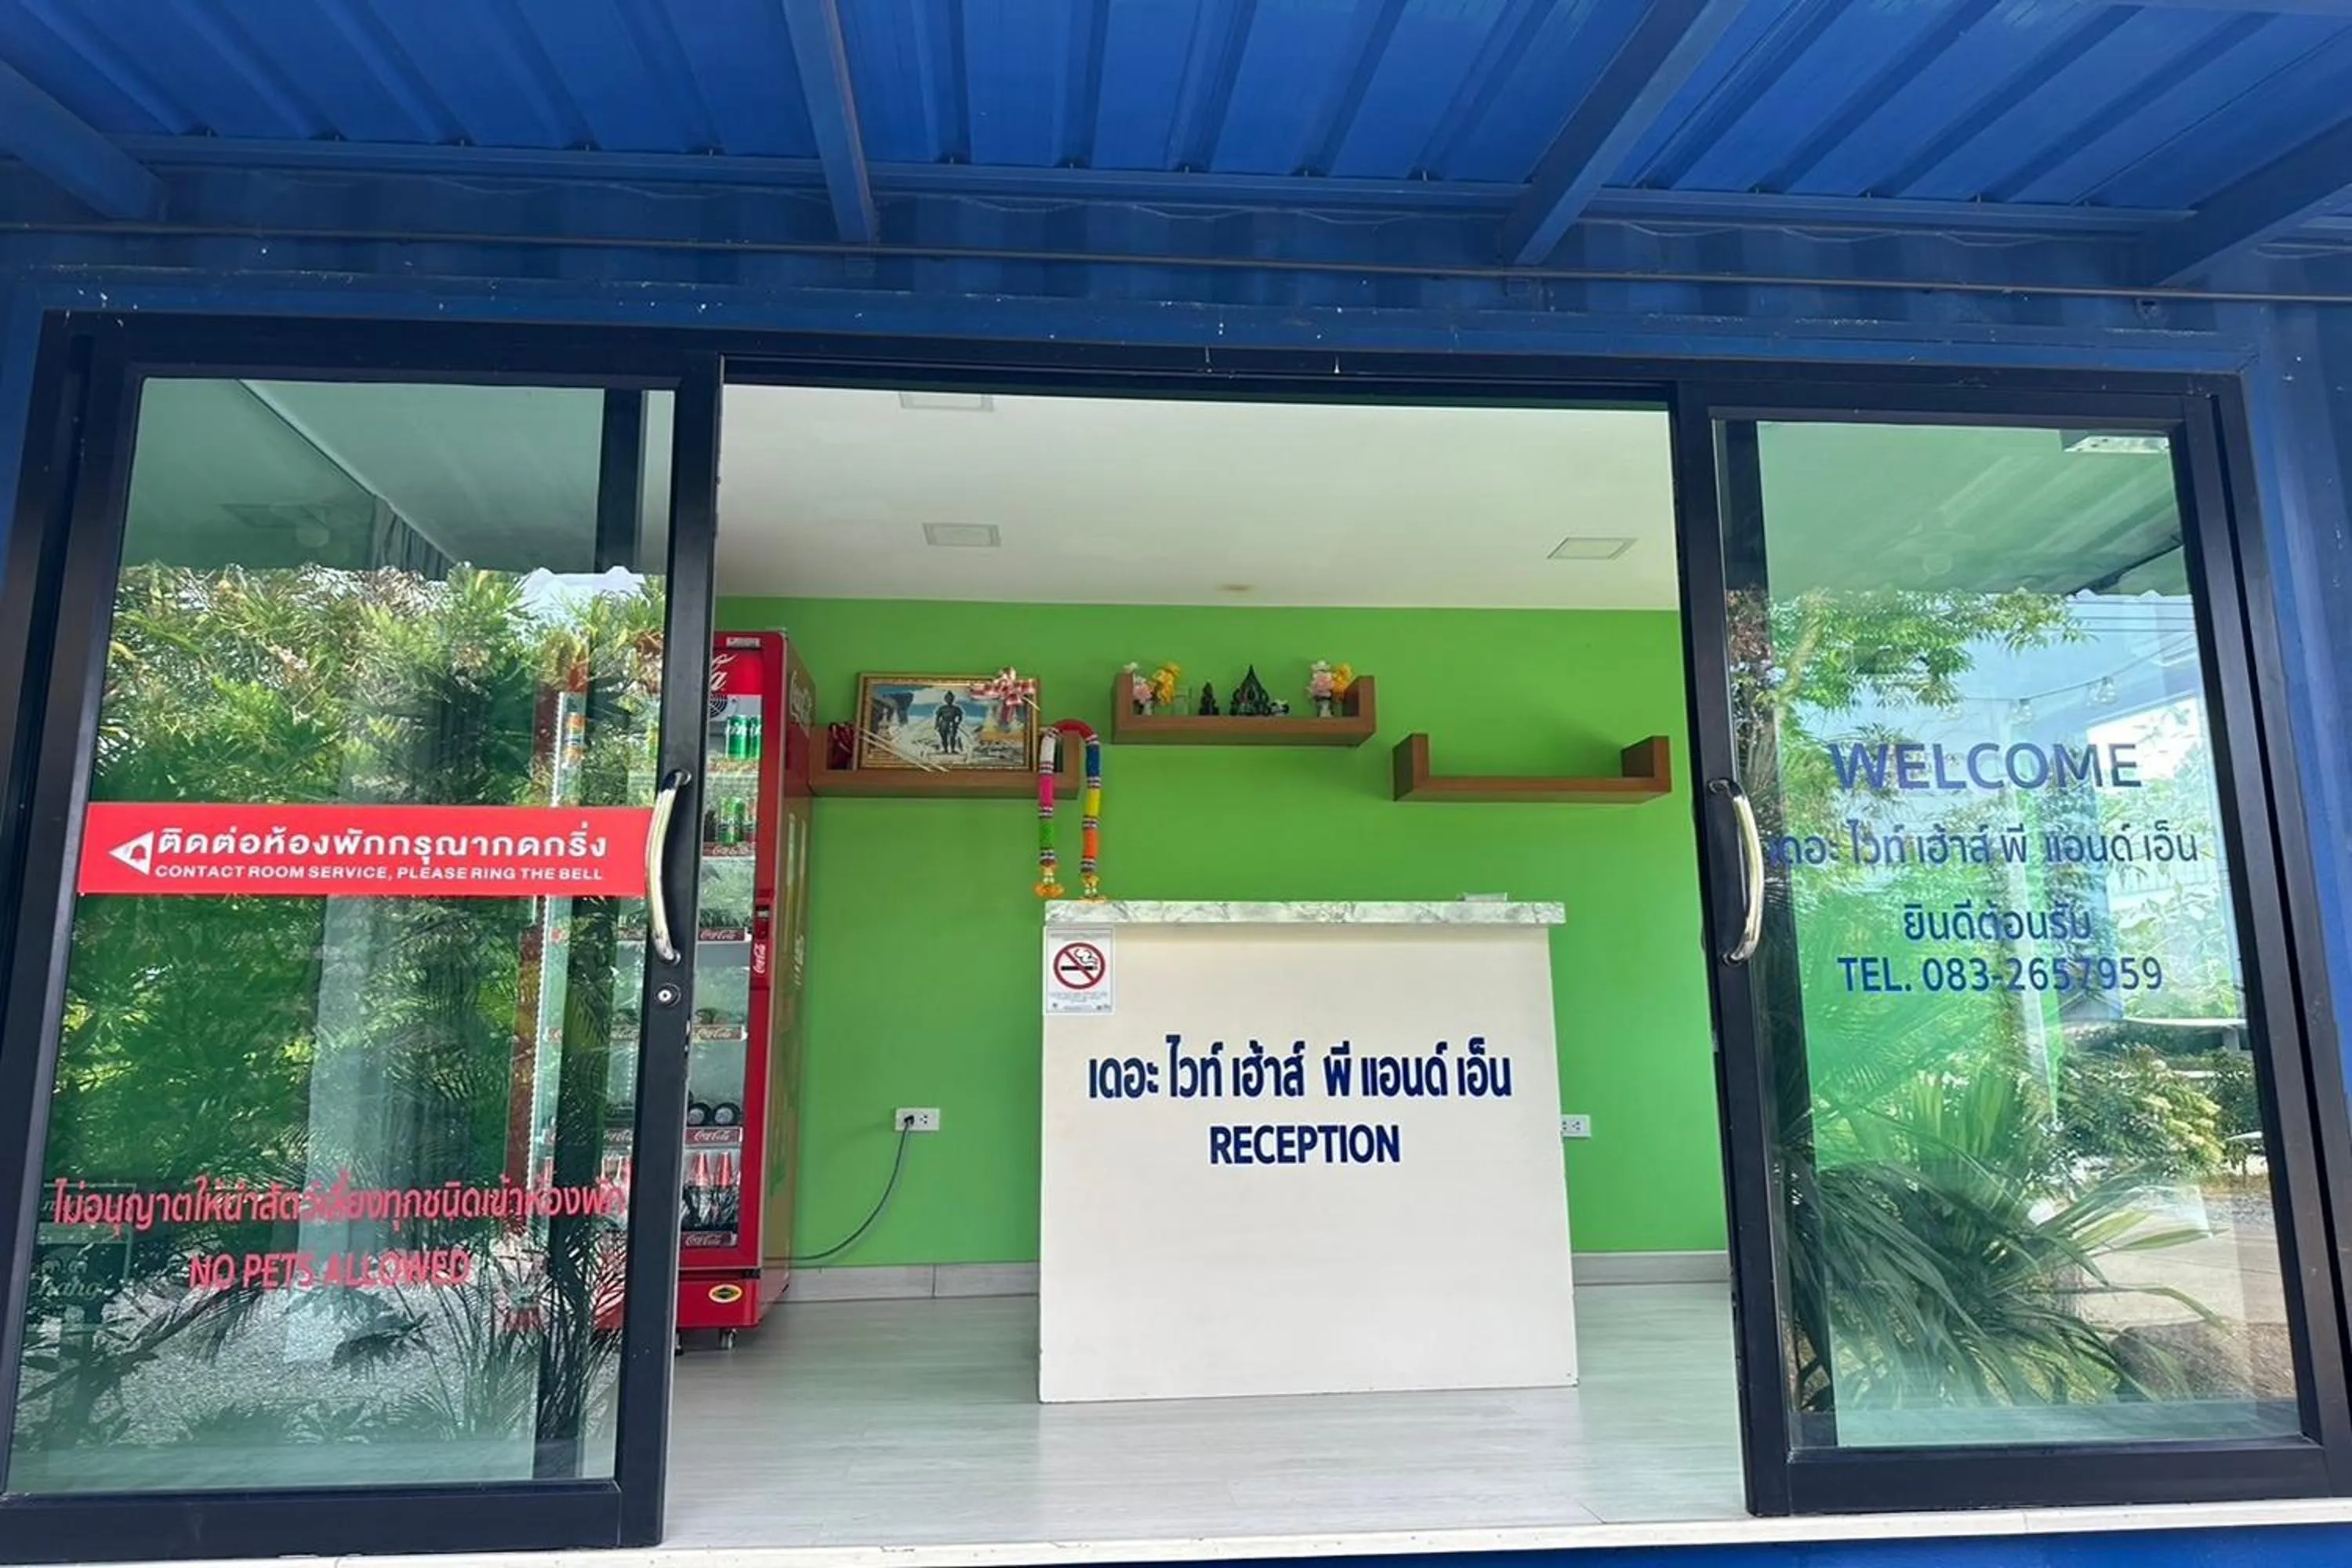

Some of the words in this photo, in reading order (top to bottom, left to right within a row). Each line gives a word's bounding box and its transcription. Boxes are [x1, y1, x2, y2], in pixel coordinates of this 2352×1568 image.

[1828, 742, 2143, 789] WELCOME
[157, 821, 607, 866] ติดต่อห้องพักกรุณากดกริ่ง
[2000, 822, 2027, 864] พี
[2144, 819, 2198, 863] เอ็น
[155, 864, 245, 878] CONTACT
[248, 866, 304, 879] ROOM
[307, 866, 393, 882] SERVICE,
[397, 866, 467, 880] PLEASE
[470, 867, 517, 880] RING
[521, 868, 556, 880] THE
[559, 868, 603, 881] BELL
[1904, 898, 2092, 942] ยินดีต้อนรับ
[1837, 956, 1911, 993] TEL.
[1922, 956, 2163, 992] 083-2657959
[1089, 1058, 1159, 1098] เดอะ
[1166, 1035, 1224, 1098] ไวท์
[1232, 1040, 1305, 1097] เฮ้าส์
[1323, 1040, 1352, 1097] พี
[1361, 1040, 1448, 1097] แอนด์
[1457, 1036, 1512, 1097] เอ็น
[1210, 1124, 1400, 1164] RECEPTION
[189, 1254, 236, 1288] NO
[242, 1253, 314, 1290] PETS
[321, 1247, 471, 1290] ALLOWED
